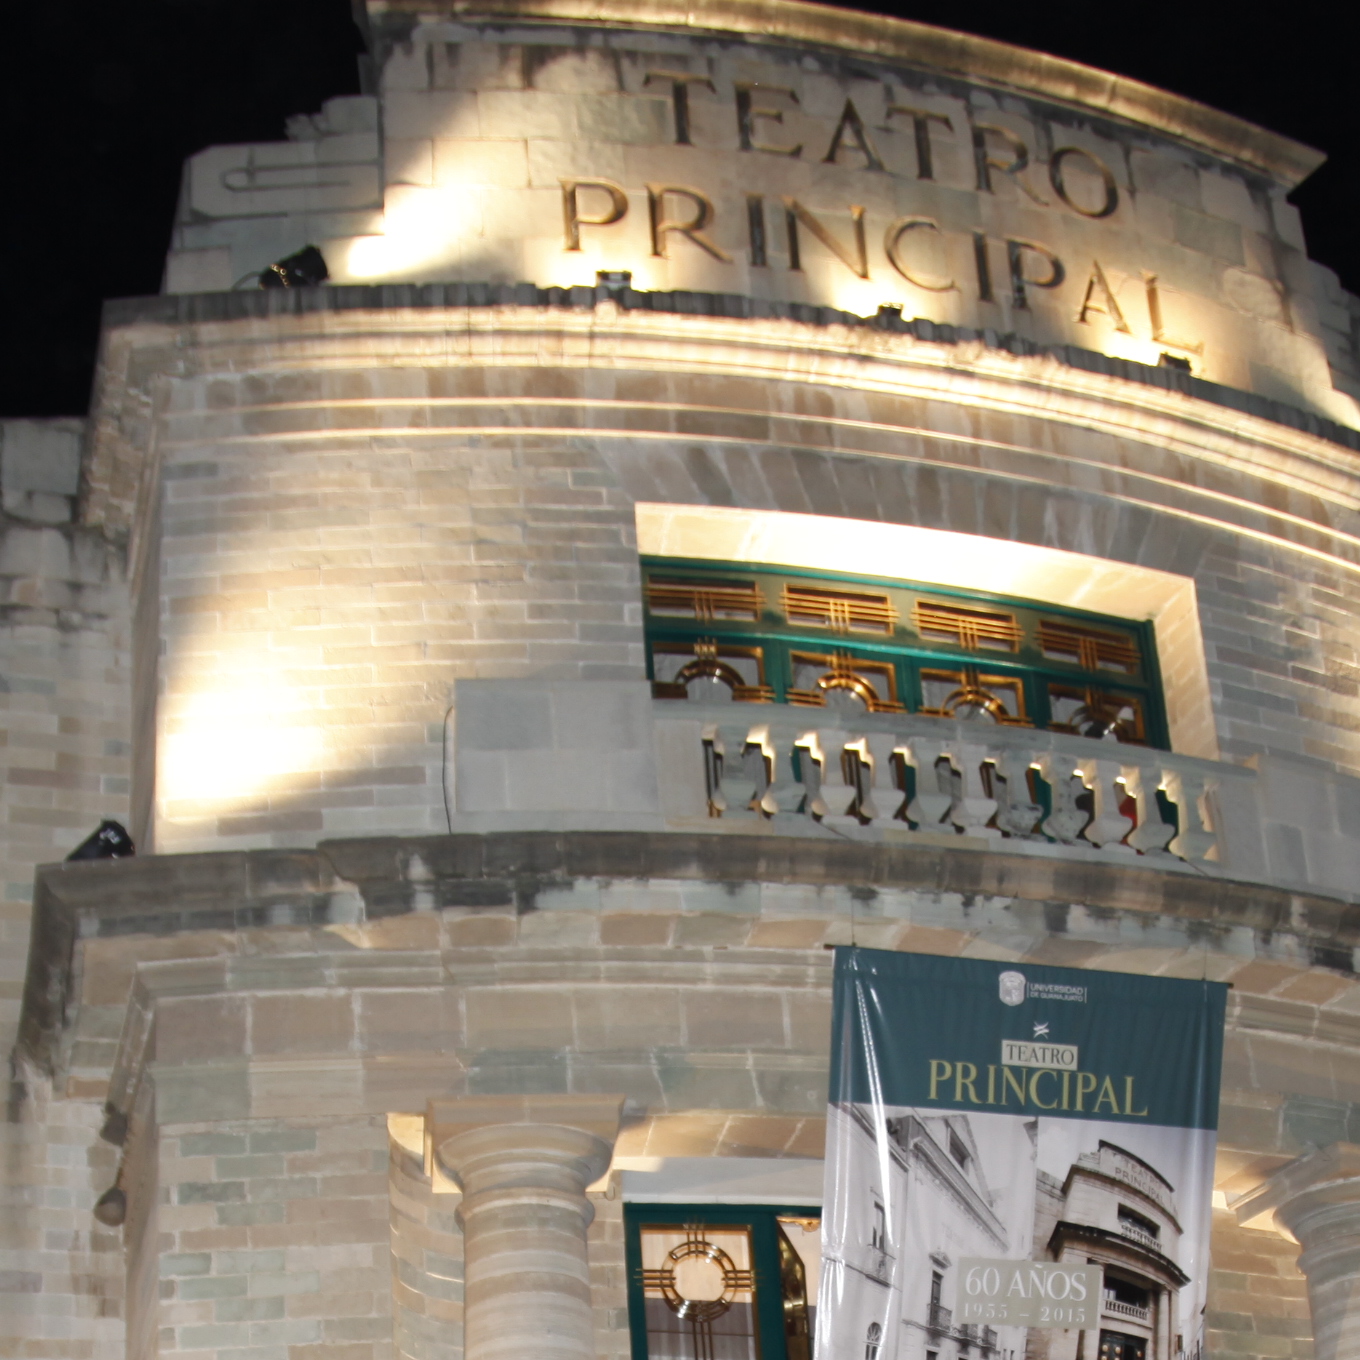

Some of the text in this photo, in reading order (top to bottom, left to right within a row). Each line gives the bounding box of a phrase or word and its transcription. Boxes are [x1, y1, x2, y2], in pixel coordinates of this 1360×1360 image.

[643, 70, 1120, 219] TEATRO
[559, 178, 1204, 358] PRINCIPAL
[1030, 983, 1084, 995] UNIVERSIDAD
[1006, 1043, 1075, 1067] TEATRO
[928, 1059, 1149, 1117] PRINCIPAL
[965, 1264, 1087, 1301] 60 AÑOS
[964, 1303, 1008, 1319] 1955
[1041, 1306, 1086, 1323] 2015
